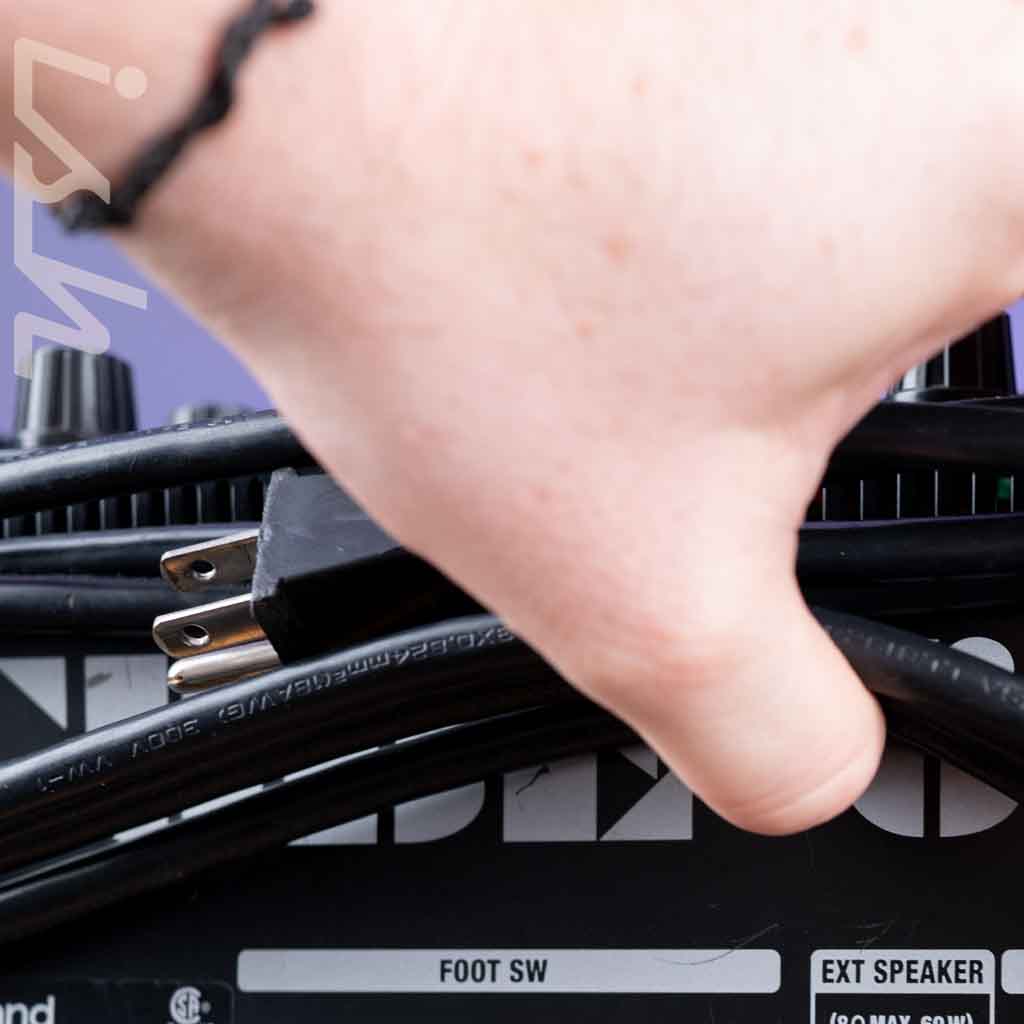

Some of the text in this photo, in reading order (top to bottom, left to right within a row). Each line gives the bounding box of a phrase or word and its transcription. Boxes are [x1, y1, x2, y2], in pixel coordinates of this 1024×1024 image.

[440, 959, 547, 983] FOOT SW
[822, 959, 984, 984] EXT SPEAKER
